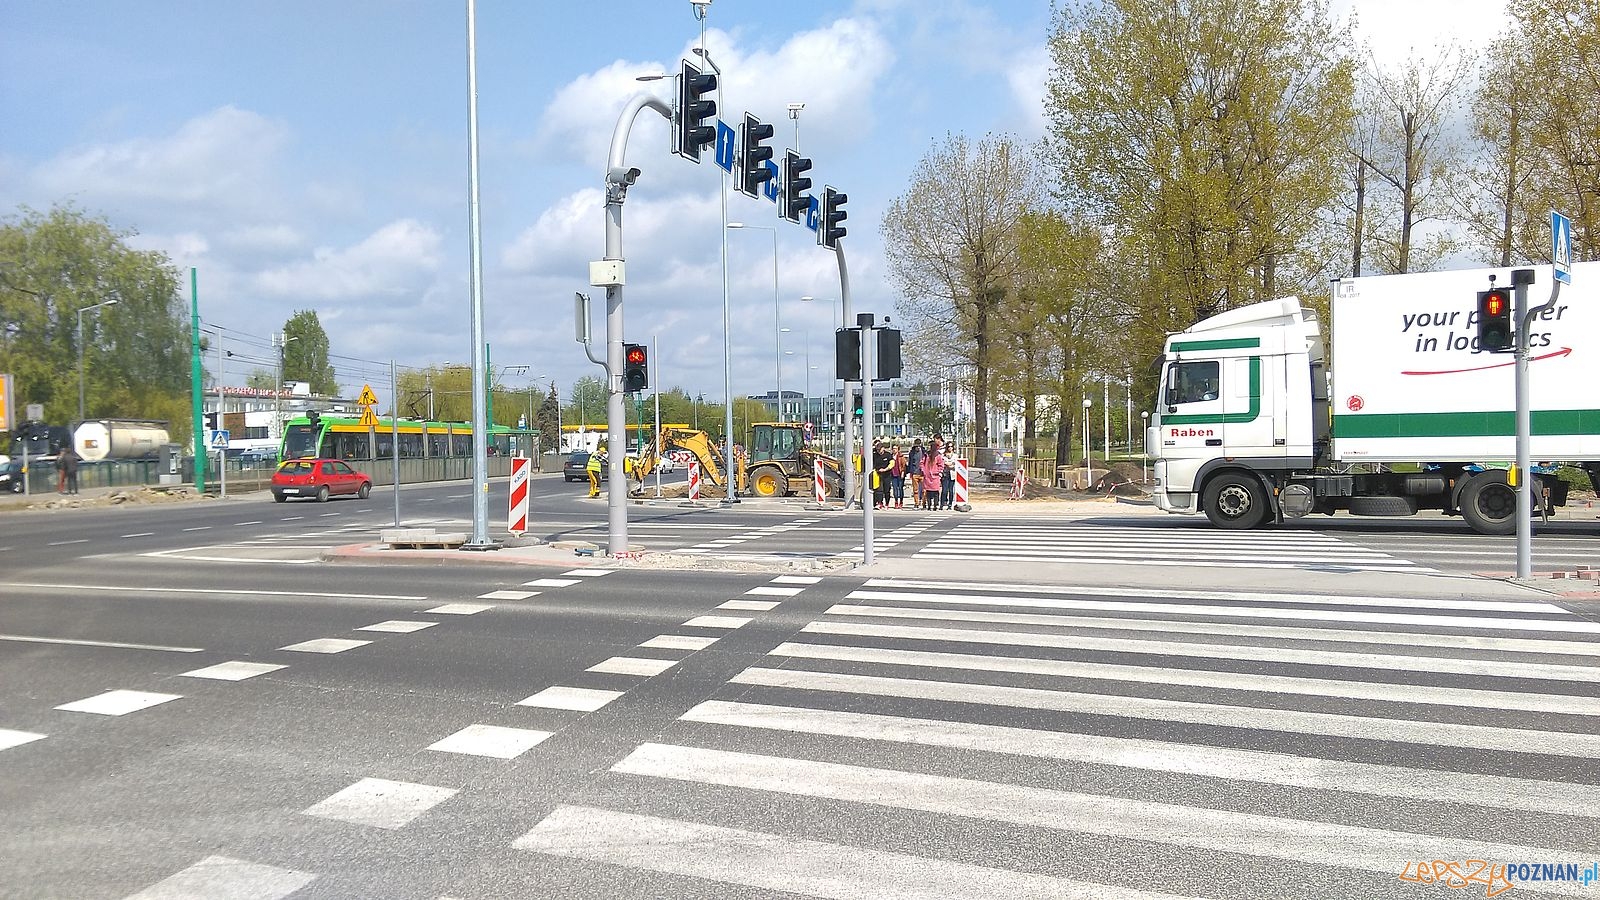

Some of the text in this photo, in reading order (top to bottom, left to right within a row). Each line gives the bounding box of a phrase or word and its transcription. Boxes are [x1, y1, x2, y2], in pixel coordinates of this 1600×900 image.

[1402, 310, 1460, 332] your
[1415, 334, 1438, 352] in
[1171, 428, 1213, 437] Raben
